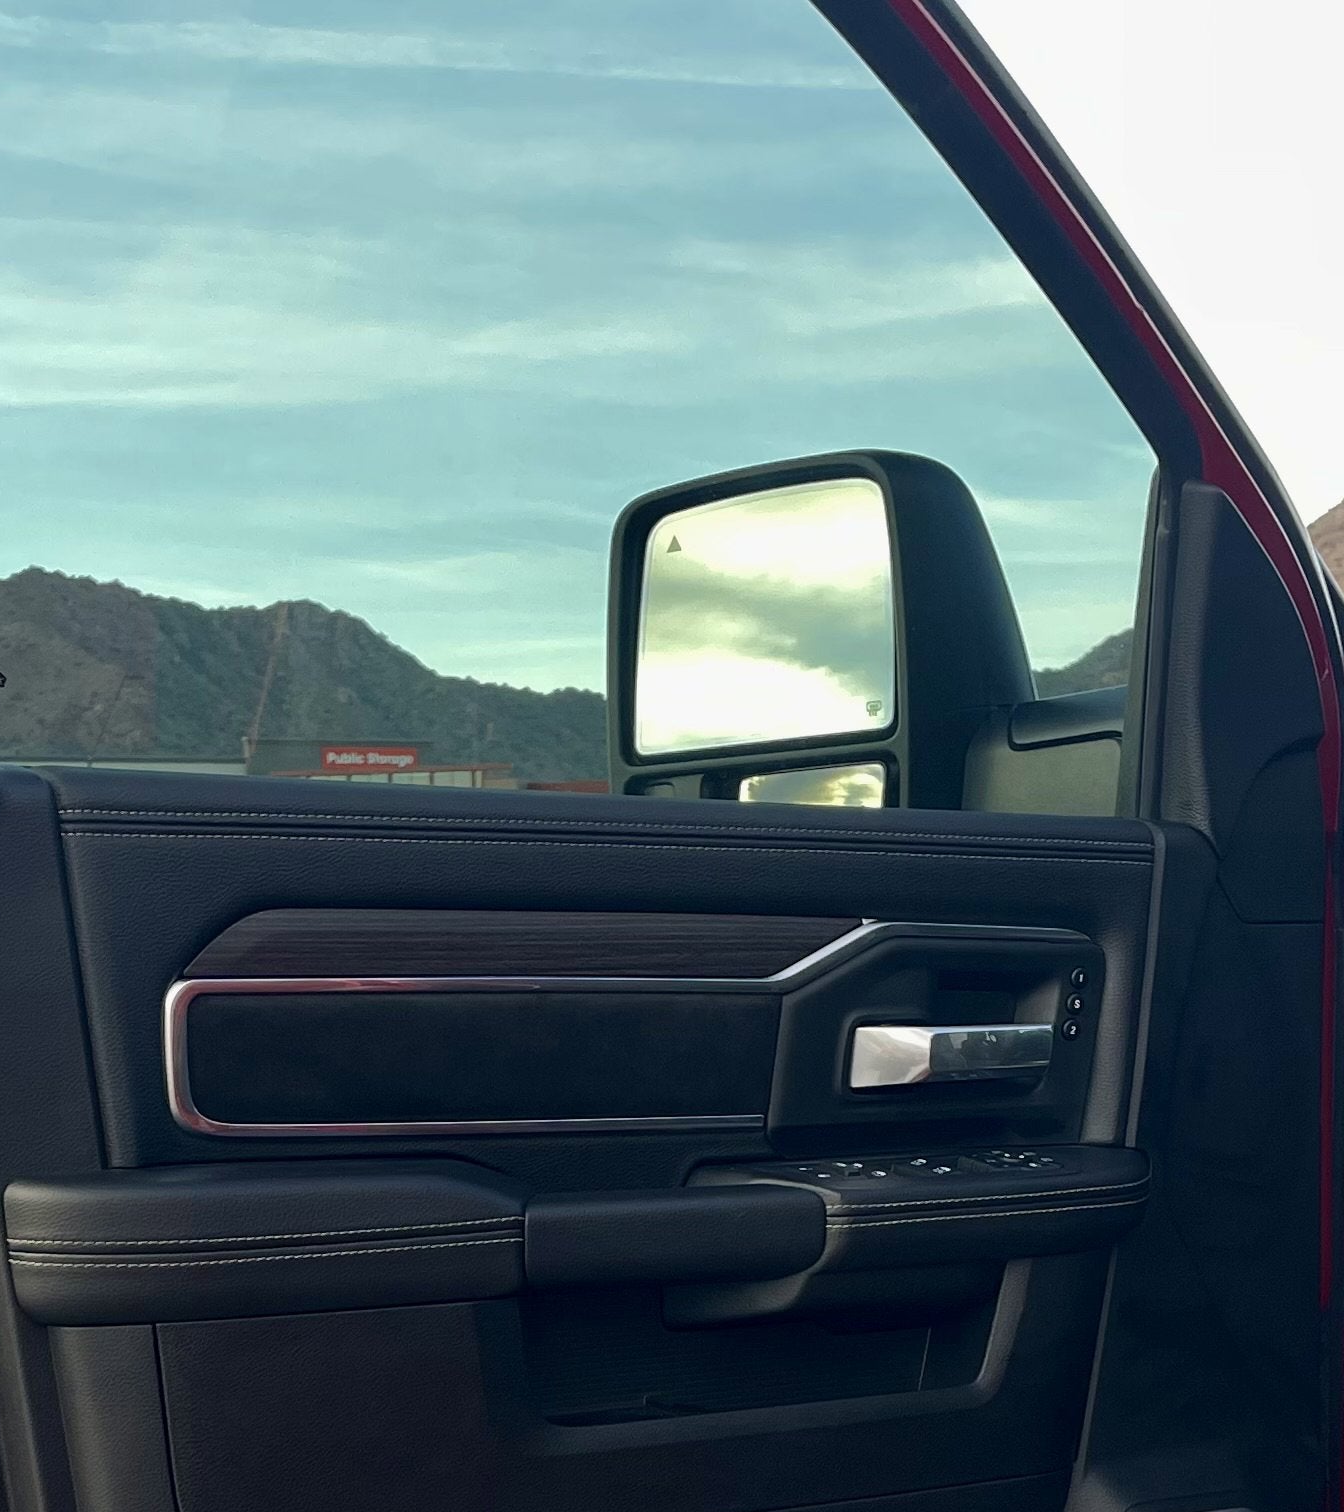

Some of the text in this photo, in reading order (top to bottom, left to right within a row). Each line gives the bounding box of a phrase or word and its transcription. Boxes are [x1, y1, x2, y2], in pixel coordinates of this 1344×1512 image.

[326, 752, 414, 767] Public Storage
[1074, 999, 1081, 1009] S
[1070, 1025, 1077, 1035] 2
